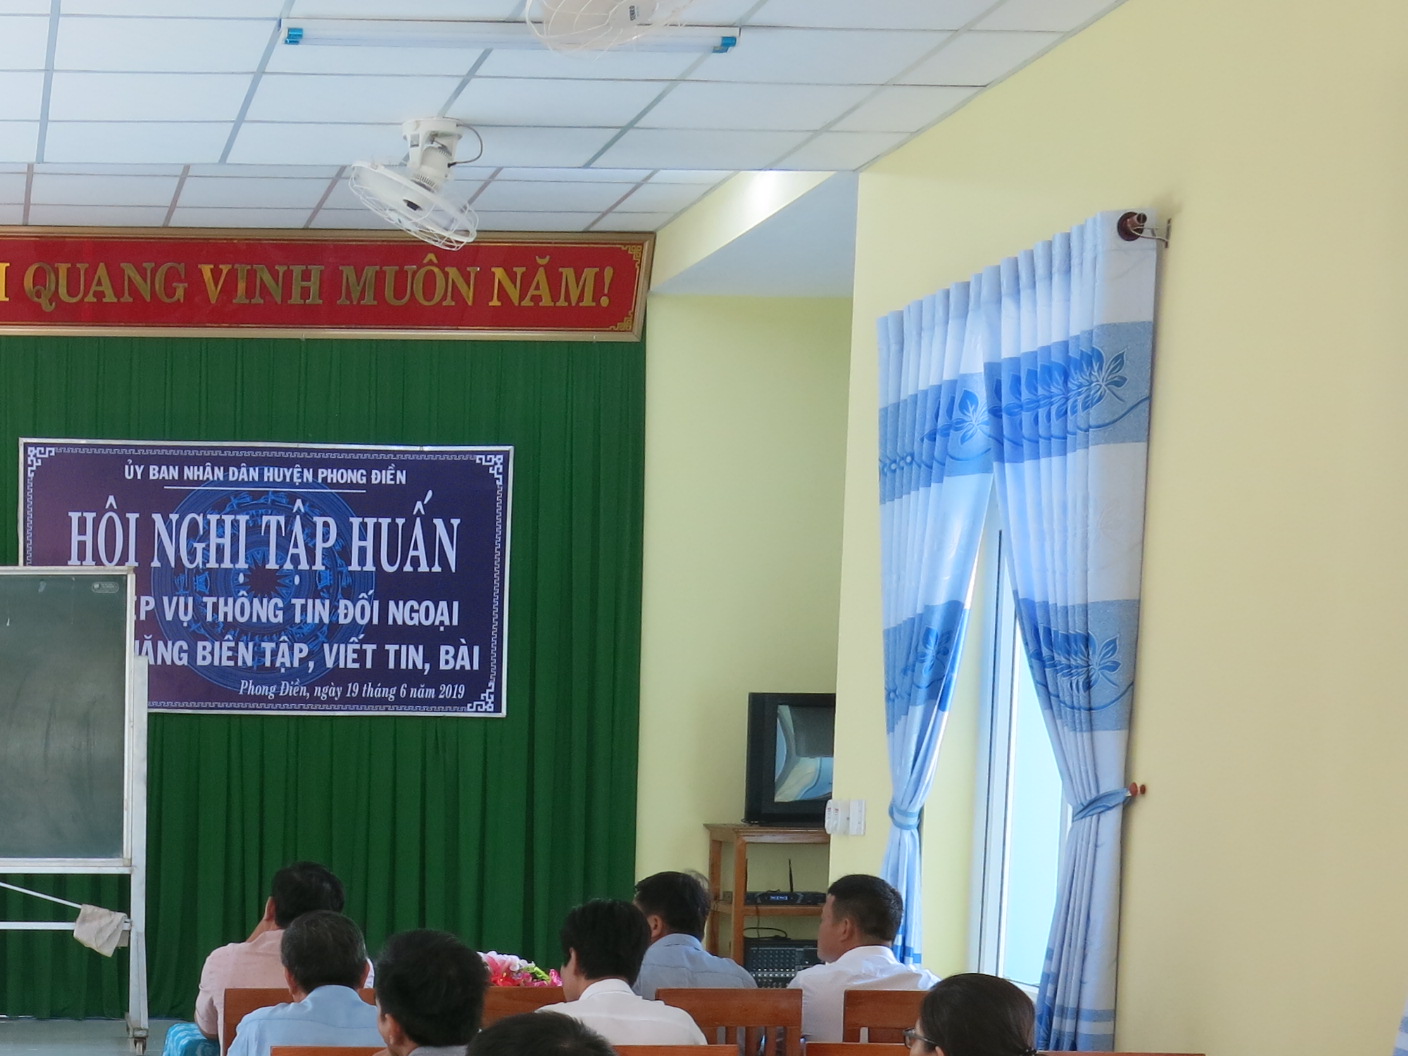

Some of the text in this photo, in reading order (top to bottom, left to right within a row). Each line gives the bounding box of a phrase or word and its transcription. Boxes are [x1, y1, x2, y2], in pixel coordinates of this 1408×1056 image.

[23, 261, 189, 312] QUANG
[198, 263, 327, 305] VINH
[337, 253, 480, 307] MUÔN
[490, 255, 614, 308] NĂM!
[124, 458, 407, 486] ỦY BAN NHÂN DÂN HUYỆN PHONG ĐIỀN
[151, 511, 251, 583] NGHỊ
[261, 498, 338, 585] TẬP
[349, 489, 461, 573] HUẤN
[162, 595, 193, 627] VỤ
[202, 590, 284, 624] THÔNG
[291, 598, 330, 624] TIN
[338, 589, 380, 625] ĐỐI
[387, 599, 459, 632] NGOẠI
[134, 634, 480, 676] ĂNG BIÊN TẬP, VIẾT TIN, BÀI
[239, 678, 466, 702] Phong Điền, ngày 19 tháng 6 năm 2019
